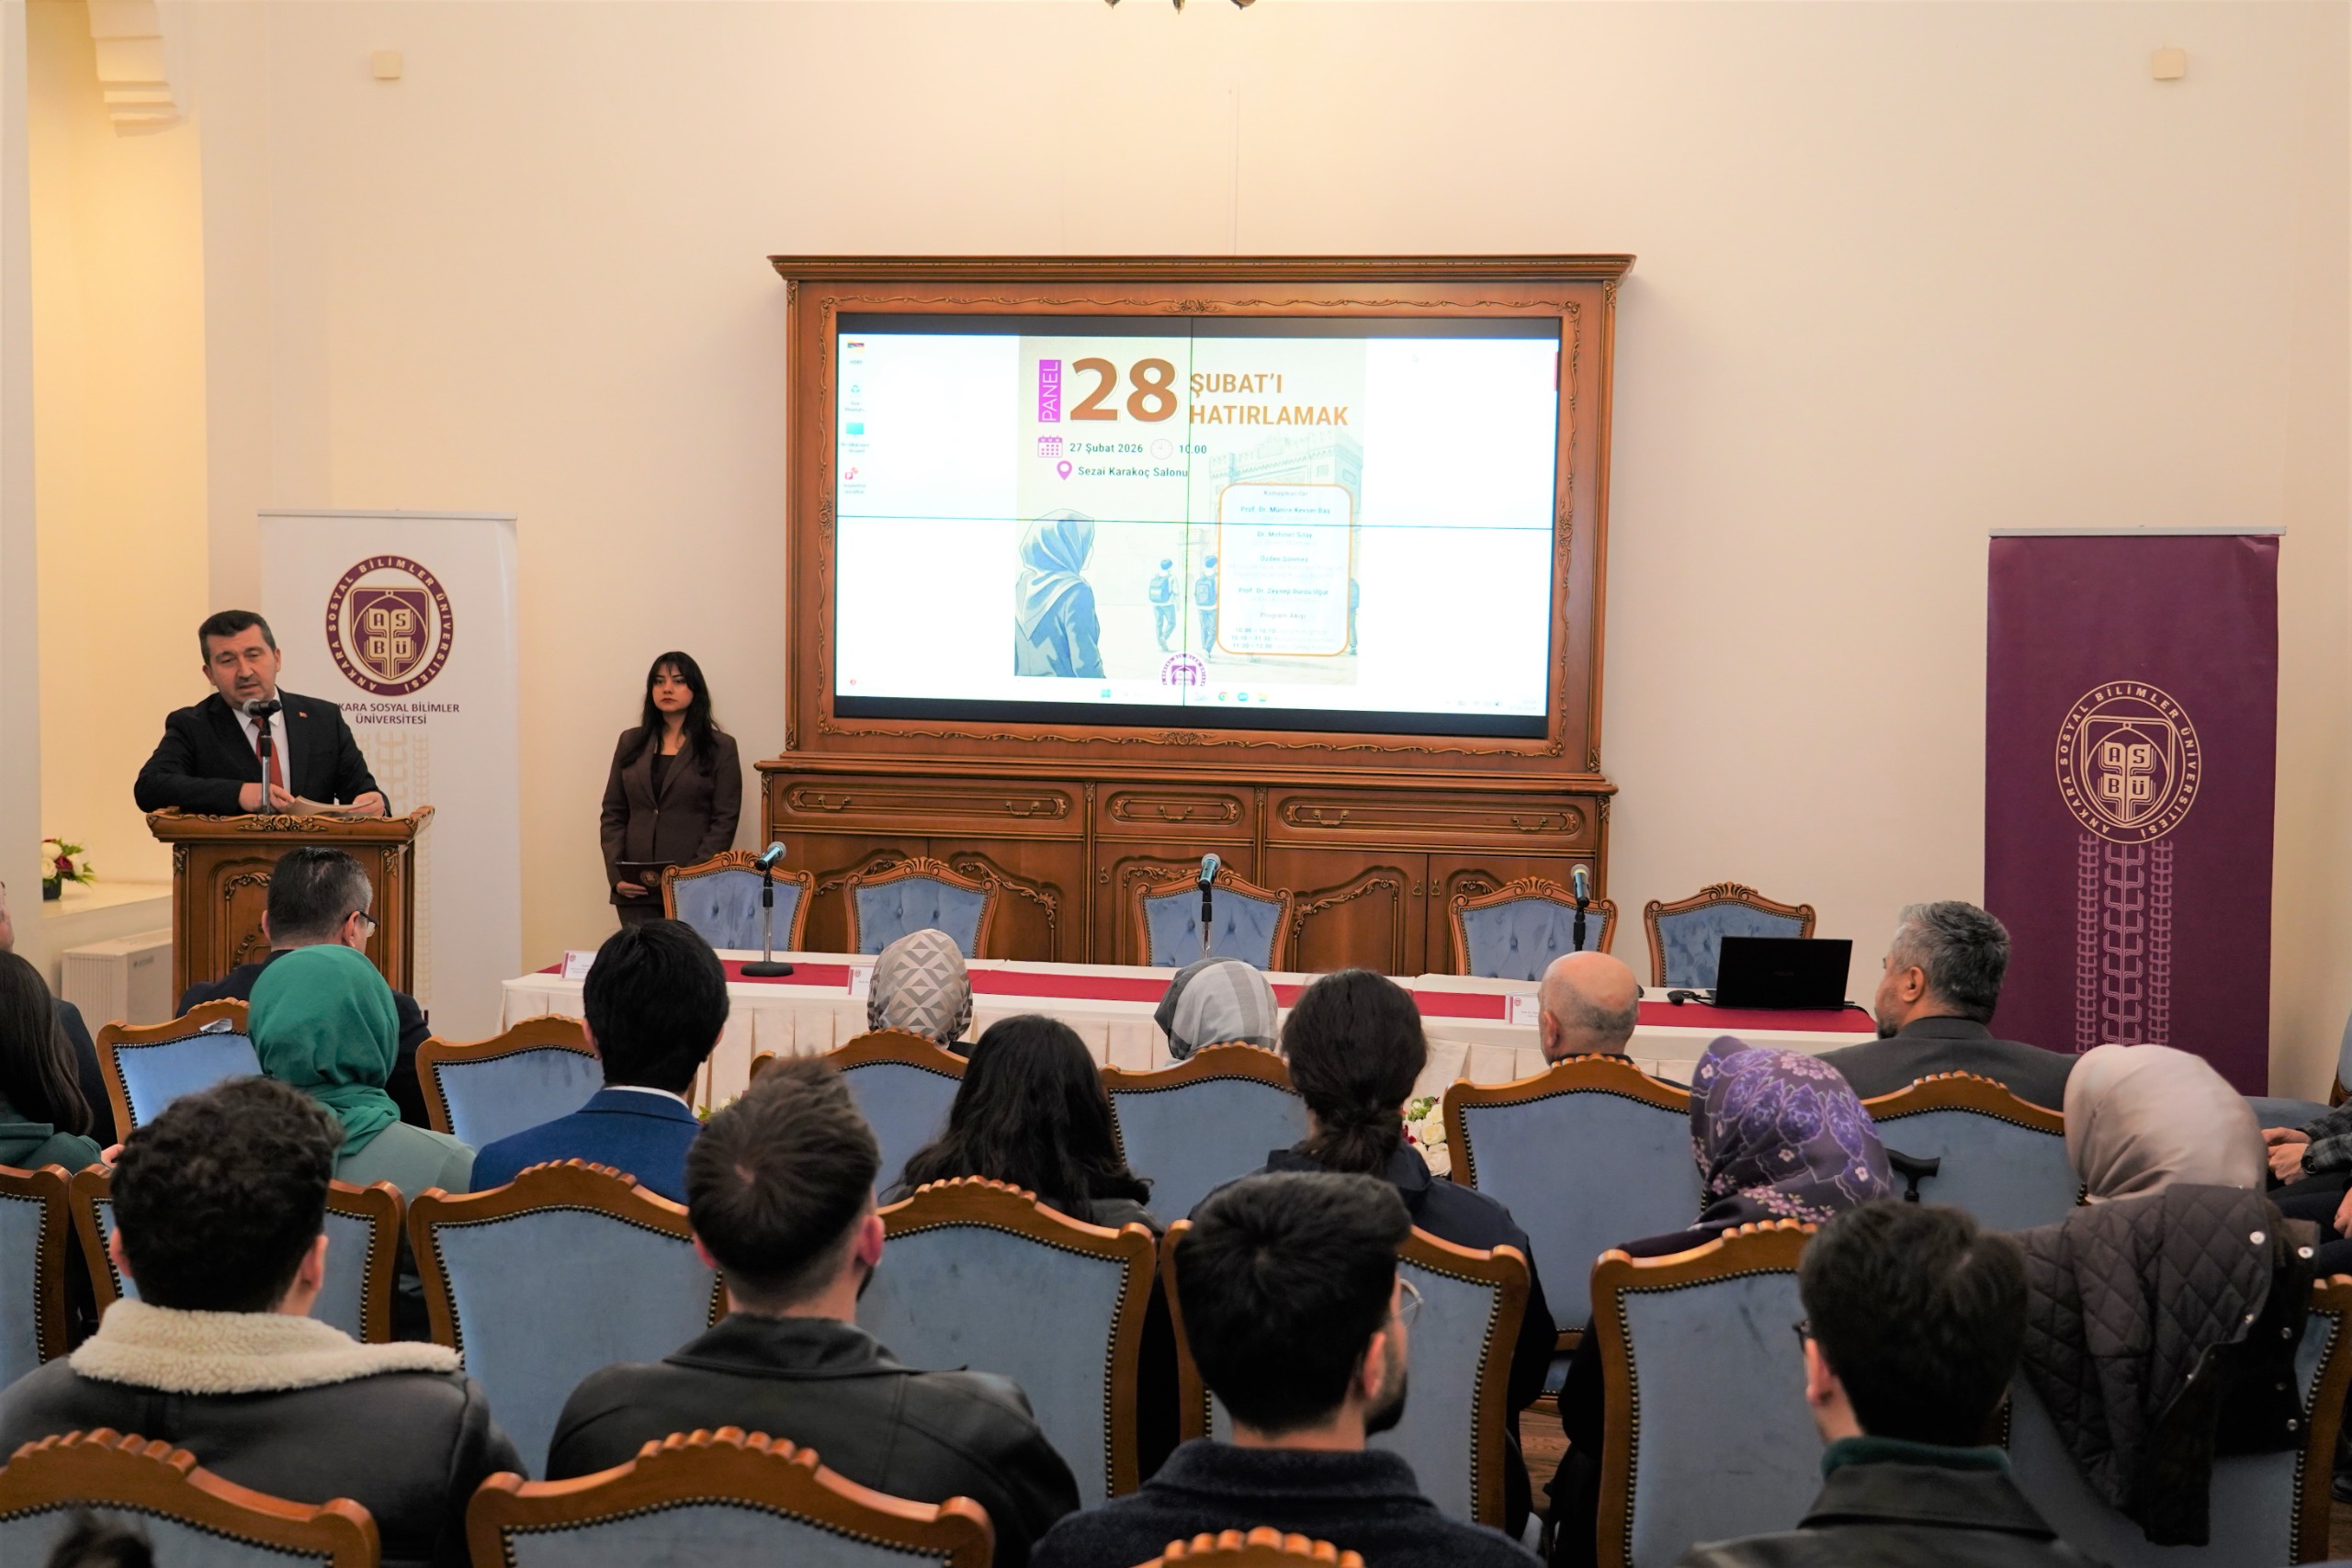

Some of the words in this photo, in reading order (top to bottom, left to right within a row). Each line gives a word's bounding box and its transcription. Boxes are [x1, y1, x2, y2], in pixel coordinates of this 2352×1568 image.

[1042, 361, 1058, 422] PANEL
[1069, 357, 1178, 423] 28
[1190, 405, 1350, 426] HATIRLAMAK
[1069, 443, 1082, 452] 27
[1085, 443, 1114, 455] Şubat
[1117, 444, 1143, 453] 2026
[1078, 466, 1105, 476] Sezai
[1109, 467, 1150, 479] Karakoç
[1153, 468, 1189, 477] Salonu
[358, 556, 434, 587] BİLİMLER
[328, 576, 354, 632] SOSYAL
[332, 640, 377, 691] ANKARA
[404, 592, 452, 694] ÜNİVERSİTESİ
[338, 703, 367, 712] KARA
[370, 703, 409, 712] SOSYAL
[412, 701, 459, 713] BİLİMLER
[356, 713, 426, 725] ÜNİVERSİTESİ
[2095, 684, 2179, 719] BİLİMLER
[2060, 705, 2088, 765] SOSYAL
[2063, 776, 2110, 833] ANKARA
[2140, 728, 2198, 839] ÜNİVERSİTESİ
